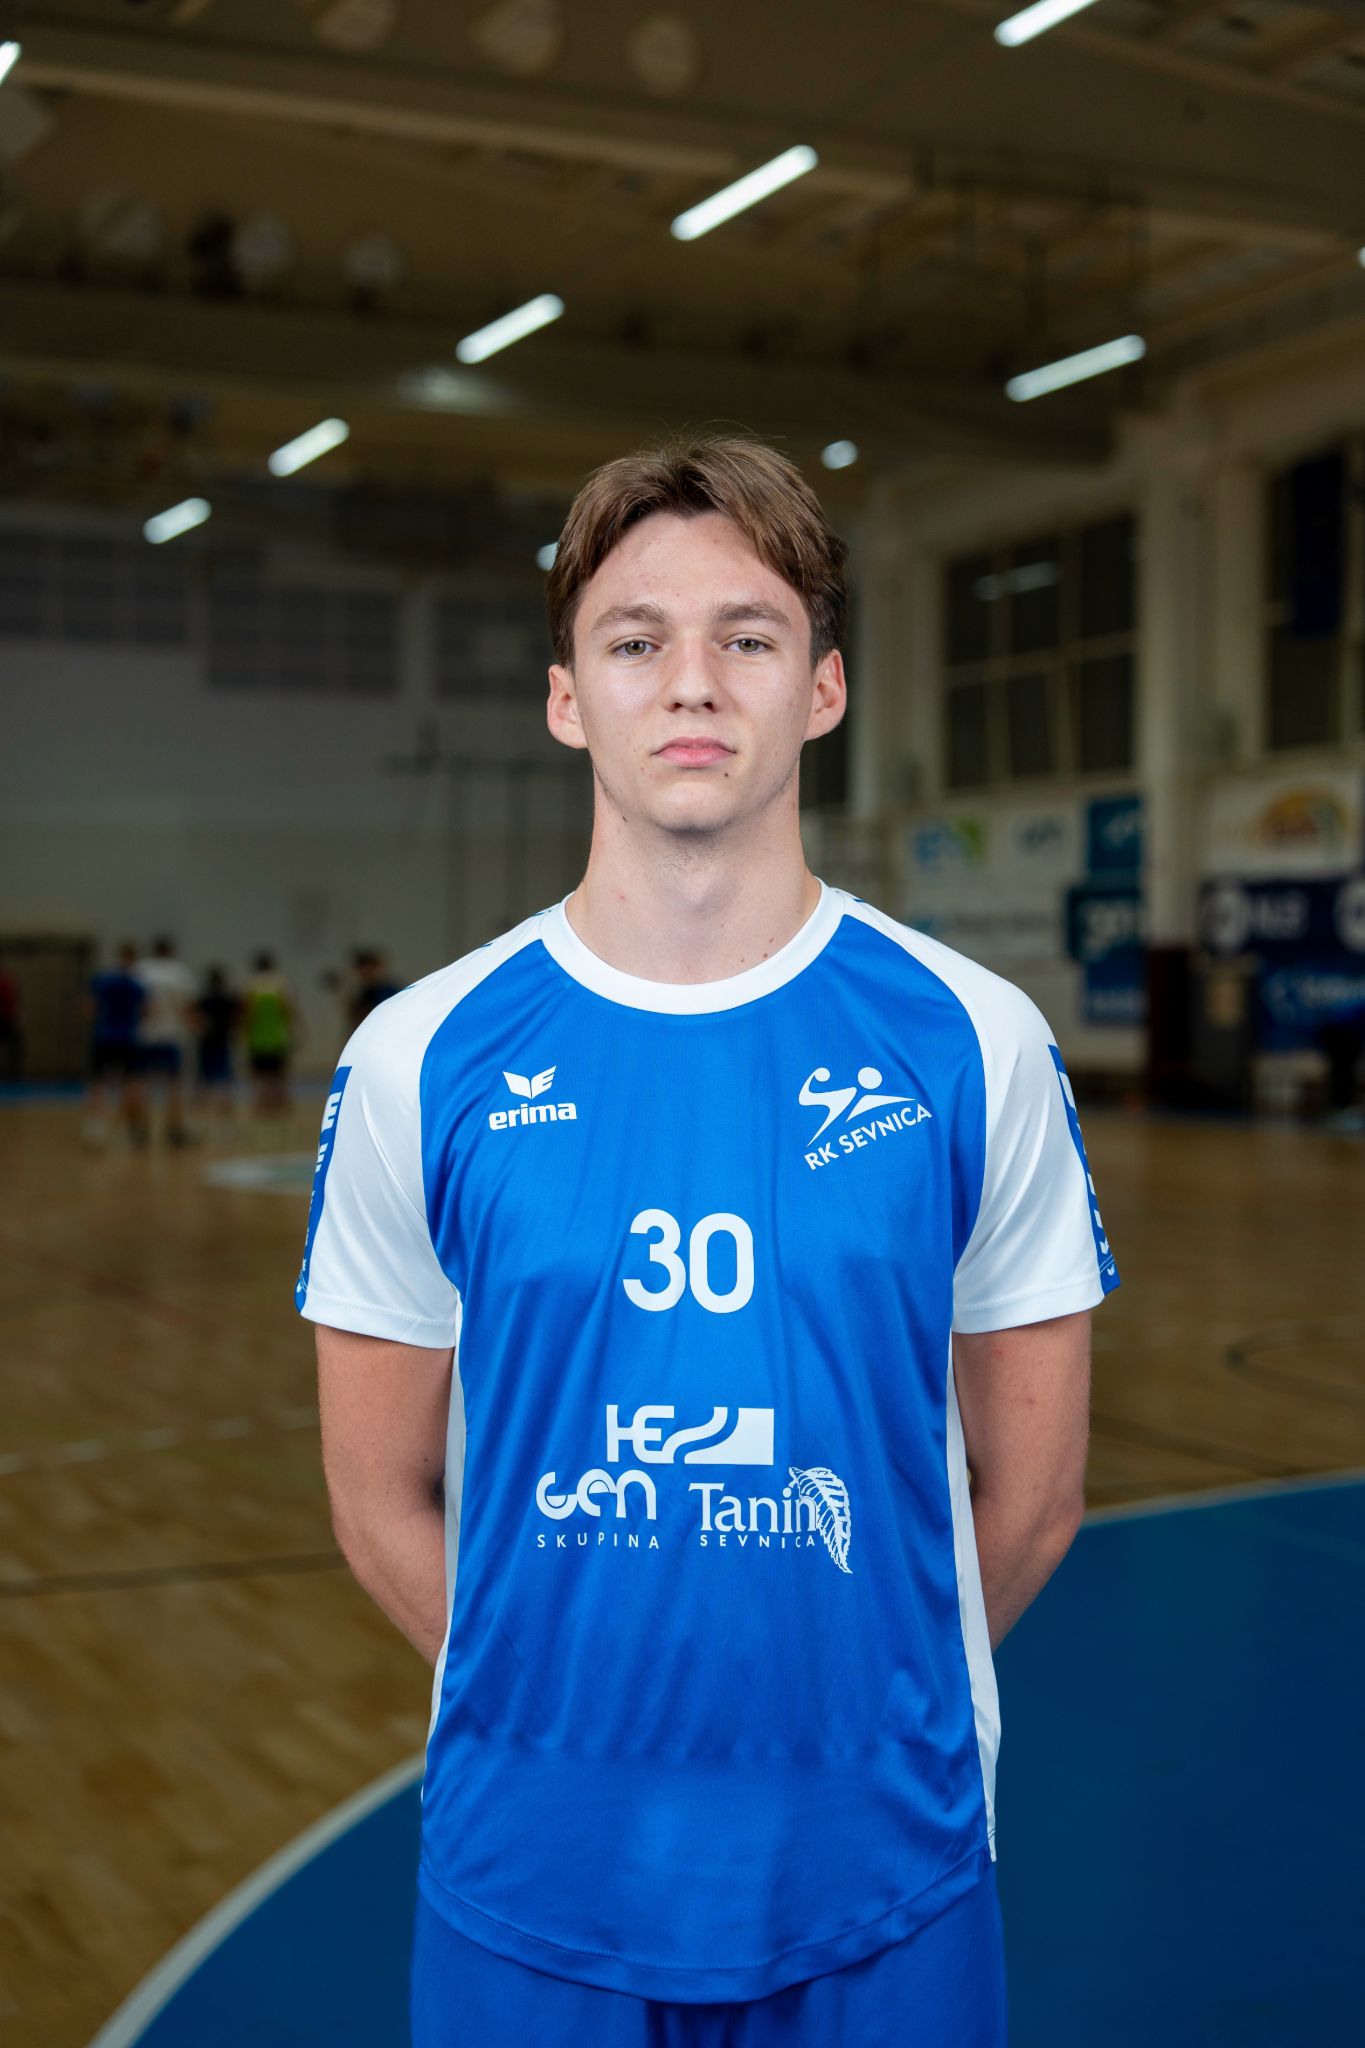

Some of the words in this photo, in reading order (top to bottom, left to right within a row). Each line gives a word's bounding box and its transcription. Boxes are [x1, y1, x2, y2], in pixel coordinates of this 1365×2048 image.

[489, 1103, 578, 1131] erima
[804, 1142, 839, 1171] RK
[838, 1104, 933, 1154] SEVNICA
[623, 1208, 755, 1314] 30
[688, 1482, 817, 1534] Tanin
[537, 1531, 660, 1550] SKUPINA
[700, 1534, 816, 1550] SEVNICA
